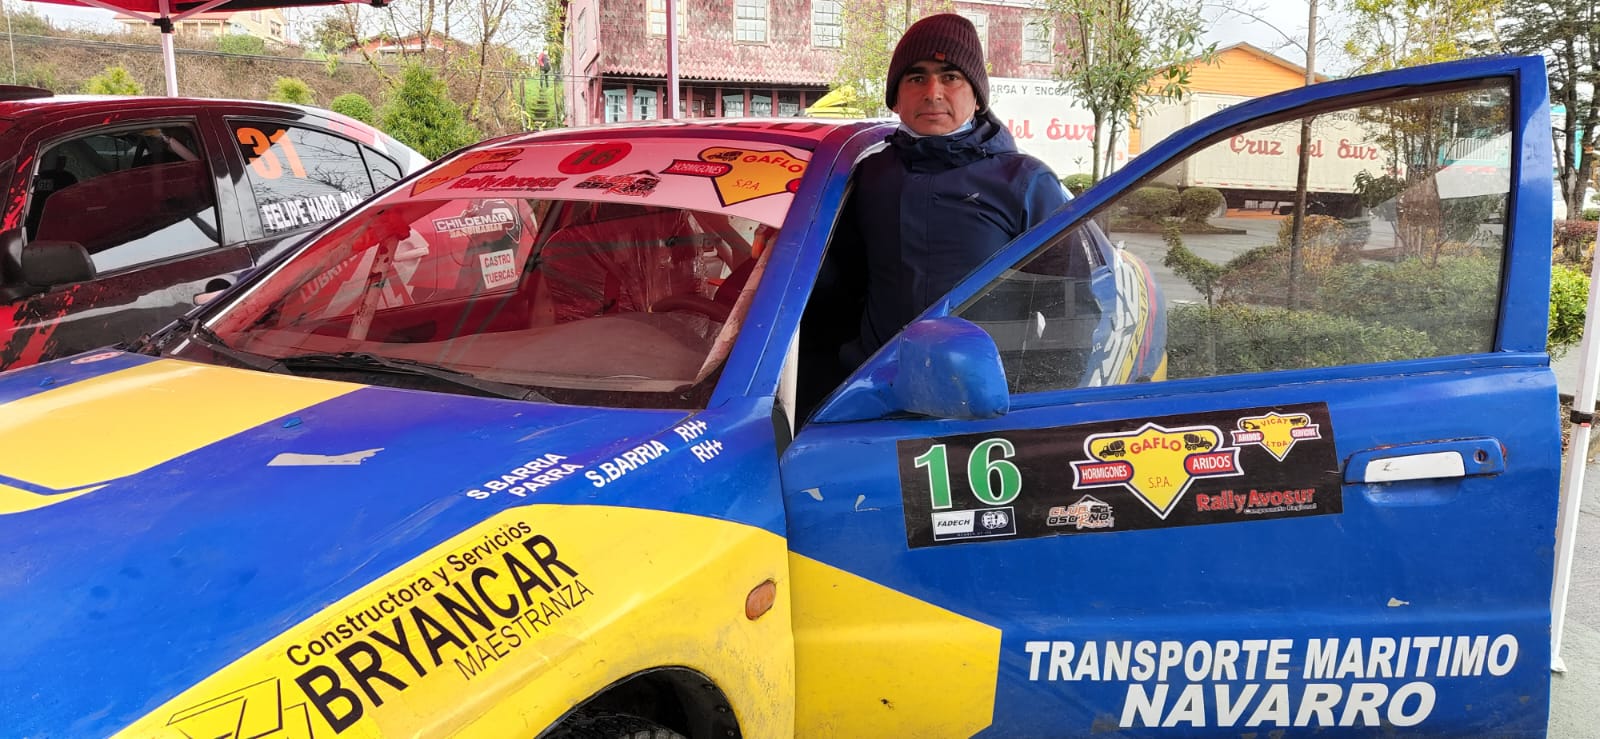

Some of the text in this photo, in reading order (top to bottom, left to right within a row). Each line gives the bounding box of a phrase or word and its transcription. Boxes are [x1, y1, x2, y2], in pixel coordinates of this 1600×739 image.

[1021, 85, 1028, 95] Y
[237, 127, 307, 179] 31
[571, 149, 620, 167] 16
[1230, 134, 1283, 156] Cruz
[1337, 138, 1378, 160] Sur
[742, 154, 803, 173] GAFLO
[732, 178, 760, 191] S.P.A.
[262, 200, 309, 230] FELIPE
[305, 195, 341, 222] HARO
[484, 253, 511, 268] CASTRO
[485, 268, 516, 284] TUERCAS
[1261, 418, 1288, 427] VICAT
[585, 419, 708, 488] S.BARRIA RH+
[690, 439, 724, 463] RH+
[1130, 437, 1182, 455] GAFLO
[914, 438, 1022, 509] 16
[1082, 464, 1127, 480] HORMIGONES
[1192, 455, 1231, 470] ARIDOS
[467, 452, 568, 500] S.BARRIA
[508, 461, 584, 497] PARRA
[1148, 476, 1173, 489] S.P.A.
[1196, 487, 1316, 513] Rally Avosur
[937, 518, 971, 528] FADECH
[286, 521, 531, 666] Constructora y Servicios
[294, 533, 579, 735] BRYANCAR
[453, 579, 594, 681] MAESTRANZA
[1025, 633, 1519, 682] TRANSPORTE MARITIMO
[1118, 680, 1436, 728] NAVARRO
